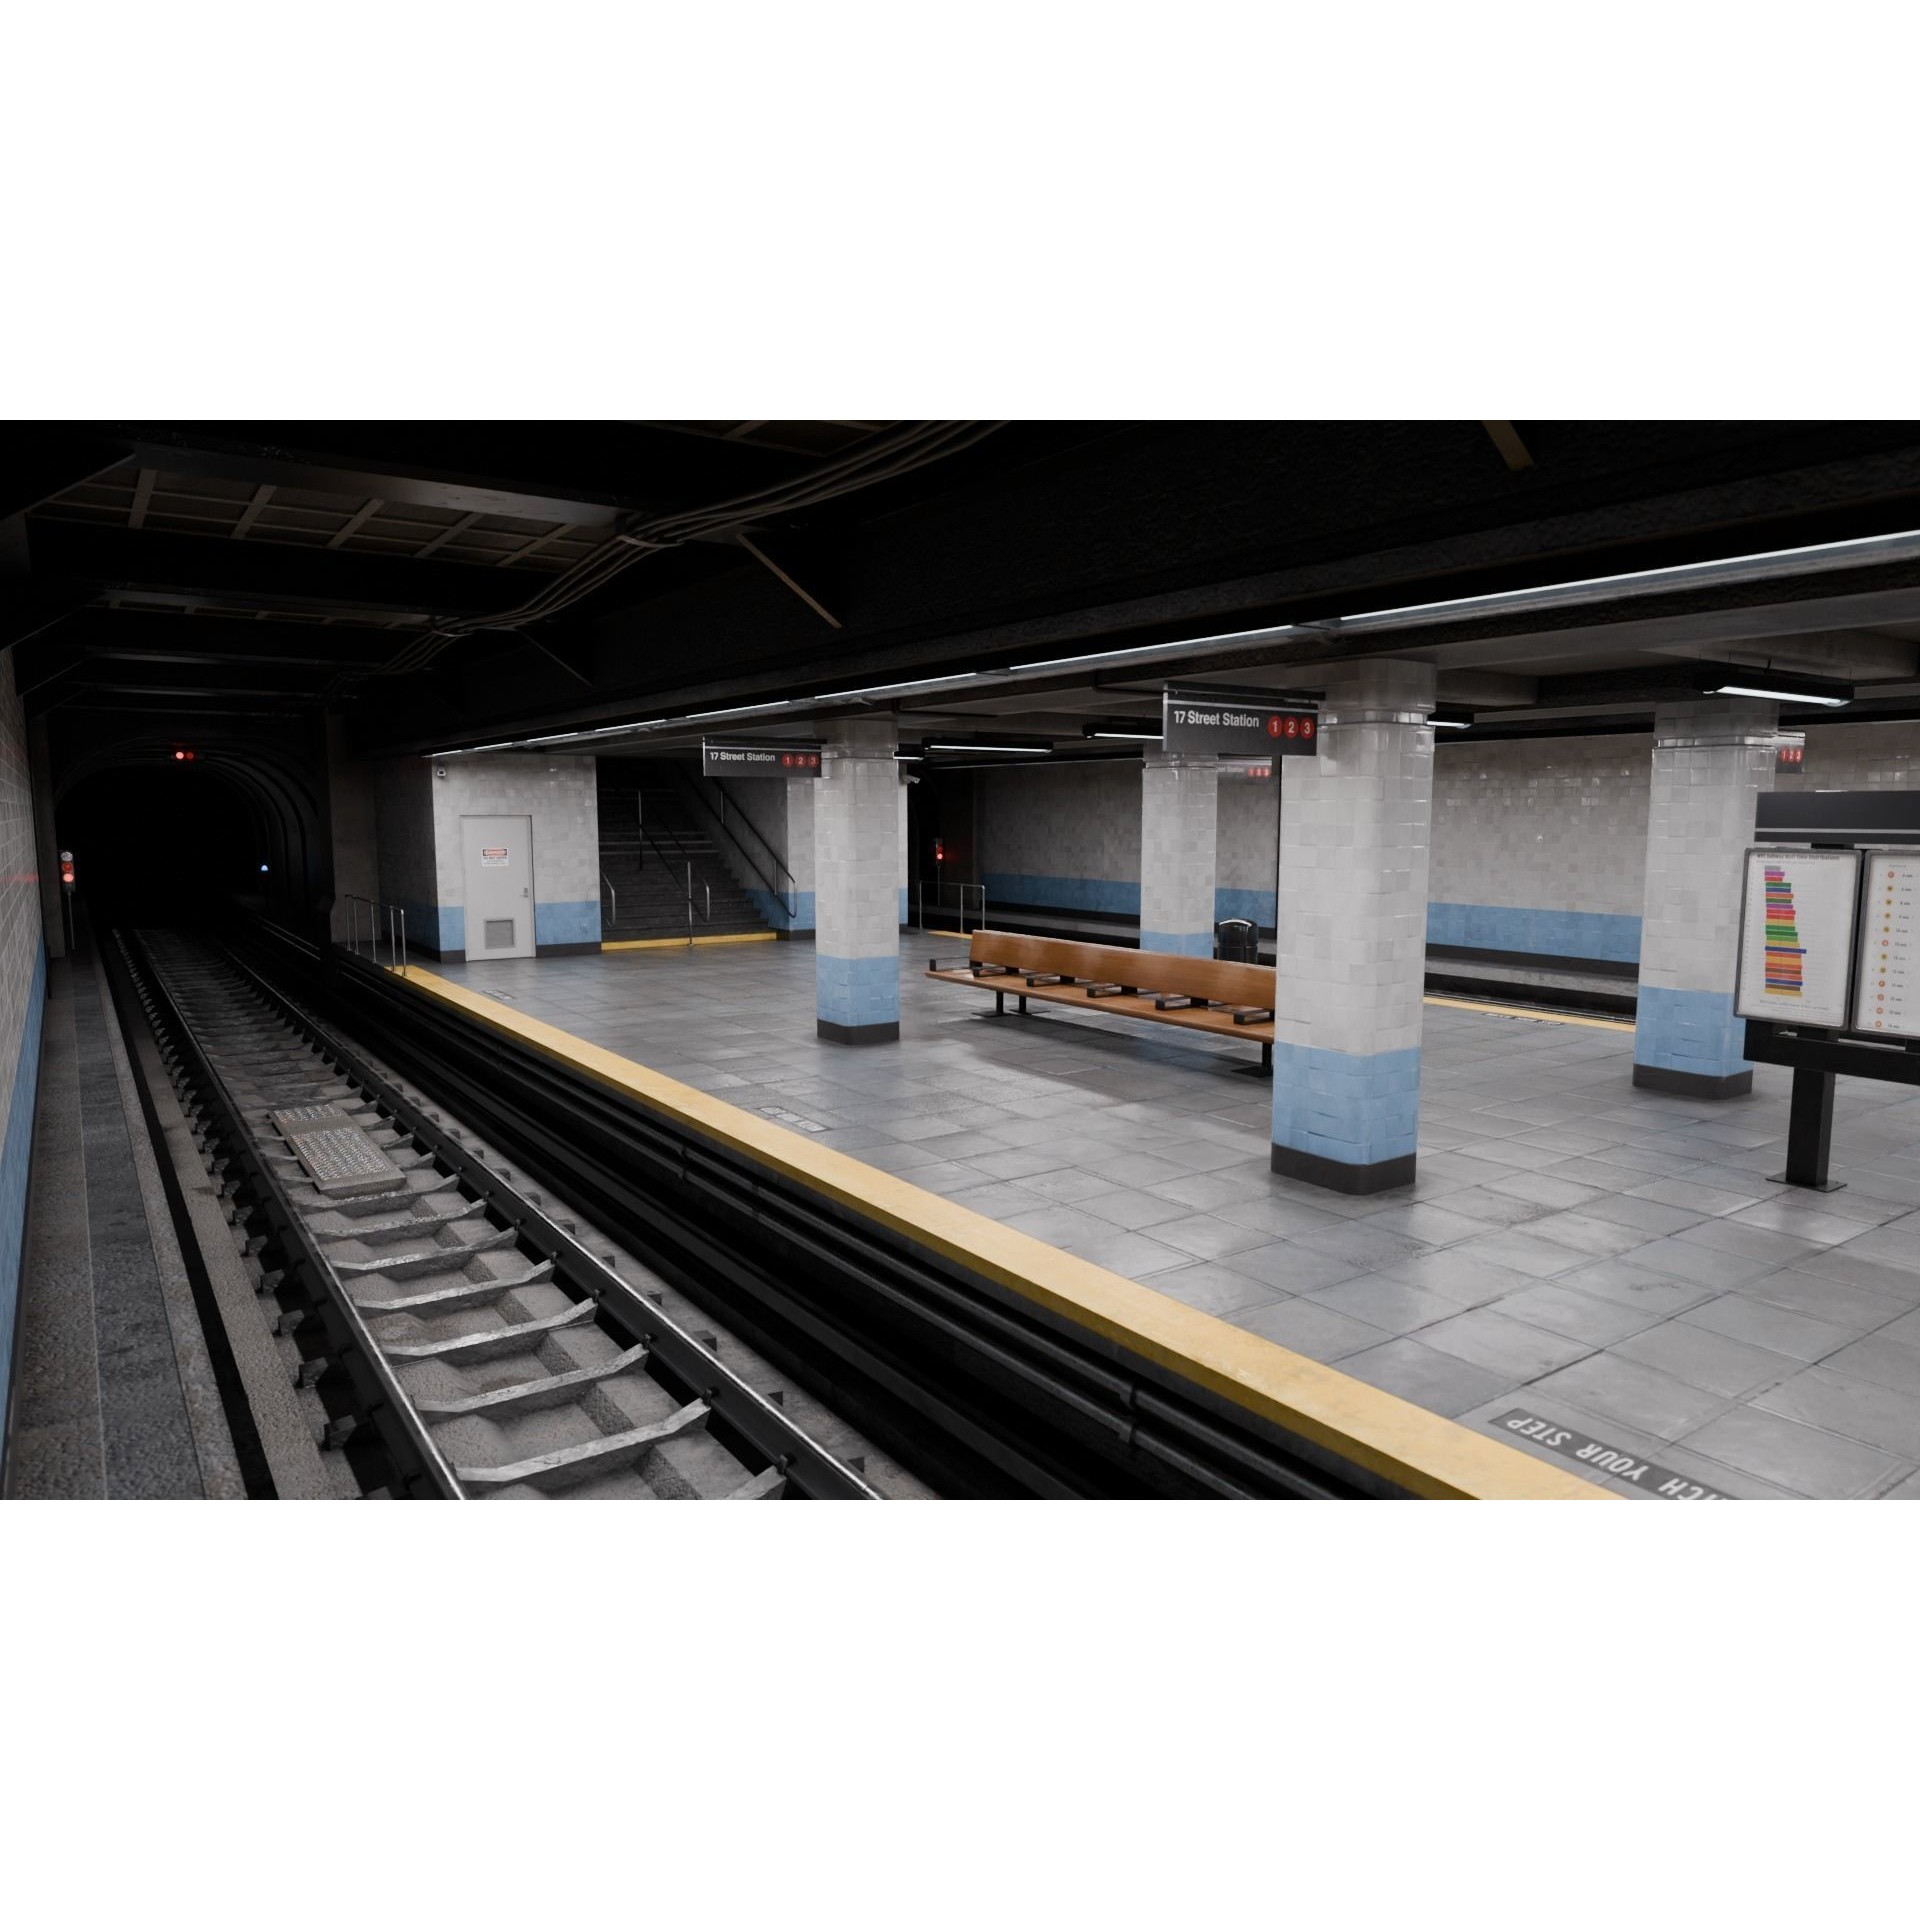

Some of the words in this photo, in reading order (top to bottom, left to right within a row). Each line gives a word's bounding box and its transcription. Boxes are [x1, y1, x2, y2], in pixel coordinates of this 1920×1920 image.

[1173, 710, 1186, 724] 17
[1187, 710, 1220, 726] Street
[1222, 712, 1260, 728] Station
[1288, 721, 1295, 734] 2
[1304, 722, 1311, 735] 3
[709, 751, 719, 761] 17
[720, 751, 745, 761] Street
[746, 752, 776, 762] Station
[1506, 1417, 1572, 1446] STEP
[1576, 1443, 1649, 1481] YOUR
